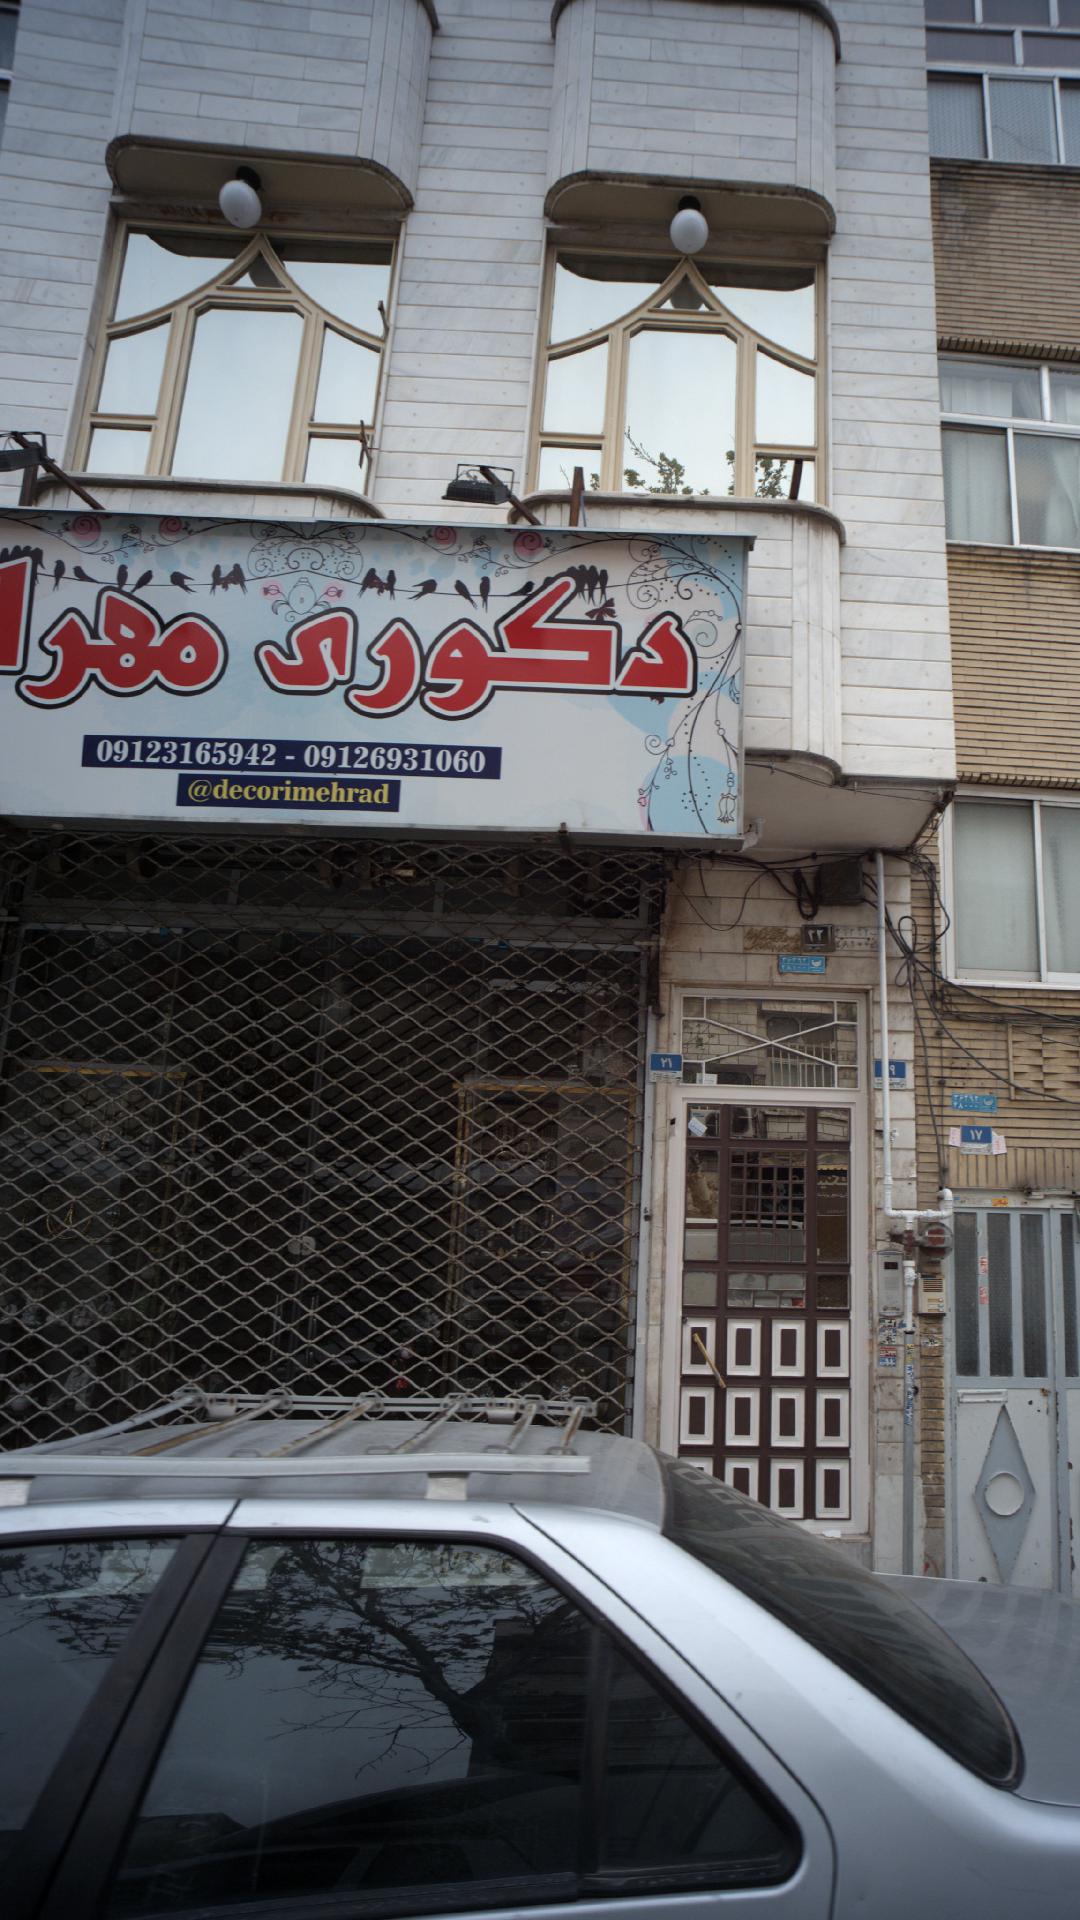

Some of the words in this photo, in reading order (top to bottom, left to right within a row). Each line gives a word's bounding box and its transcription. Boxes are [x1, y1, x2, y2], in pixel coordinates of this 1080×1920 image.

[255, 574, 698, 720] دکوری
[96, 739, 278, 767] 09123165942
[303, 744, 487, 773] 09126931060
[187, 778, 390, 804] @decorimehrad
